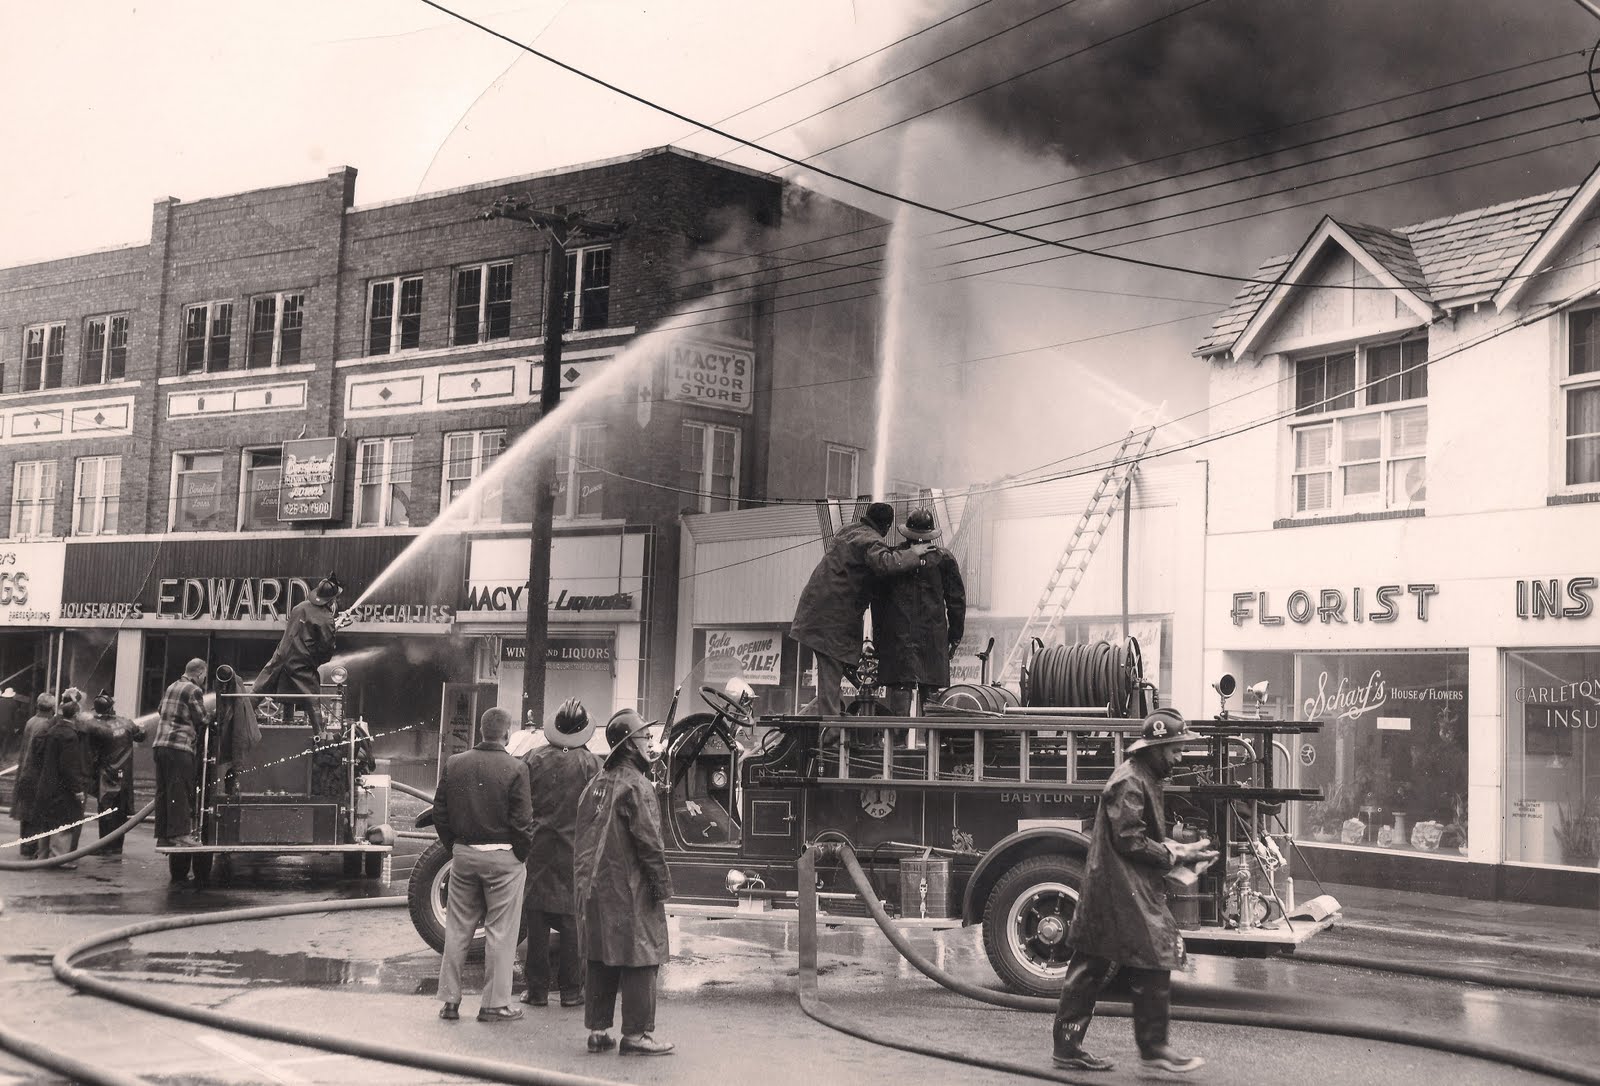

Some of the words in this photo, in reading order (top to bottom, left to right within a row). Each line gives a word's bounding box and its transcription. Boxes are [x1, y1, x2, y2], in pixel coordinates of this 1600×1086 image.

[672, 347, 746, 376] MACY'S
[673, 367, 744, 390] LIQUOR
[680, 382, 742, 403] STORE
[260, 496, 279, 506] Loan
[156, 577, 311, 622] EDWARD
[464, 581, 531, 611] MACY'
[1231, 583, 1440, 626] FLORIST
[1516, 577, 1599, 620] INS
[59, 603, 143, 620] HOUSEWARES
[355, 604, 451, 624] SPECIALTIES
[707, 632, 732, 653] Gala
[736, 638, 773, 657] OPENING
[506, 647, 526, 658] WIN
[545, 649, 559, 657] ND
[562, 647, 610, 659] LIQUORS
[741, 653, 780, 673] SALE!
[950, 665, 980, 682] ARKING
[1303, 669, 1387, 721] Scharf's
[1419, 689, 1428, 700] of
[1547, 709, 1598, 729] INSU
[1001, 793, 1073, 803] BABYLON
